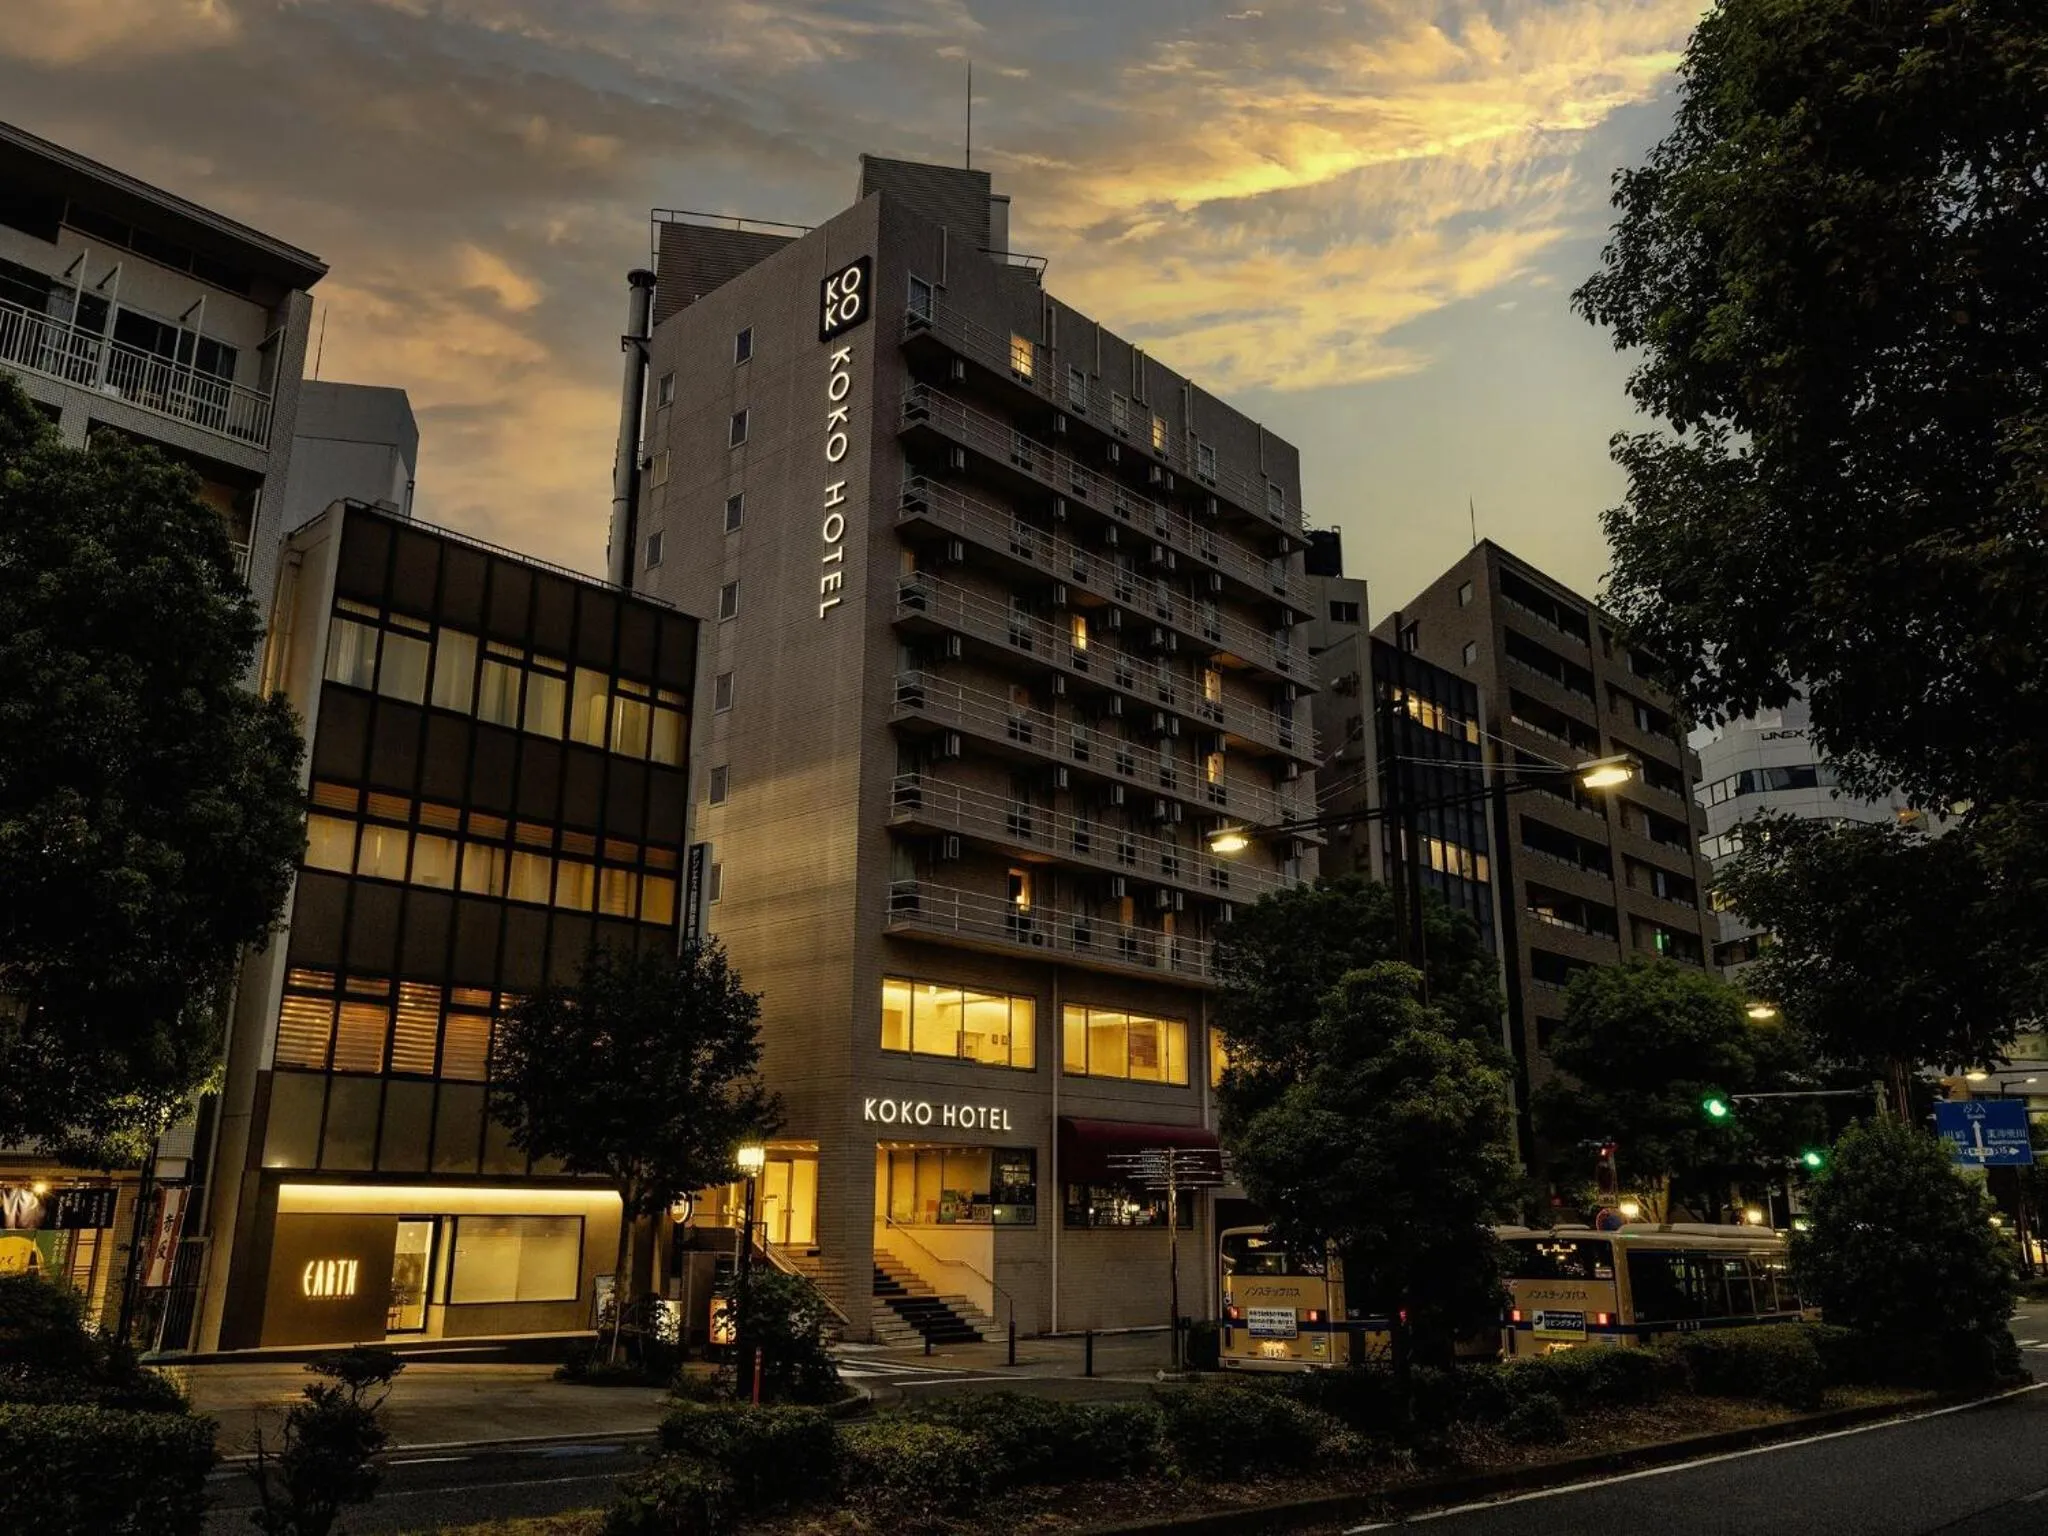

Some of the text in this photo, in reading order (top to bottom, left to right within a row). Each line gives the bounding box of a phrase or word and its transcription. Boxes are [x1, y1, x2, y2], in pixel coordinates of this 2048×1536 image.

[826, 265, 861, 303] KO
[824, 293, 860, 332] KO
[819, 346, 851, 619] KOKO HOTEL
[864, 1097, 1012, 1131] KOKO HOTEL
[303, 1259, 359, 1296] EARTH
[1244, 1287, 1301, 1297] ノンステップバス
